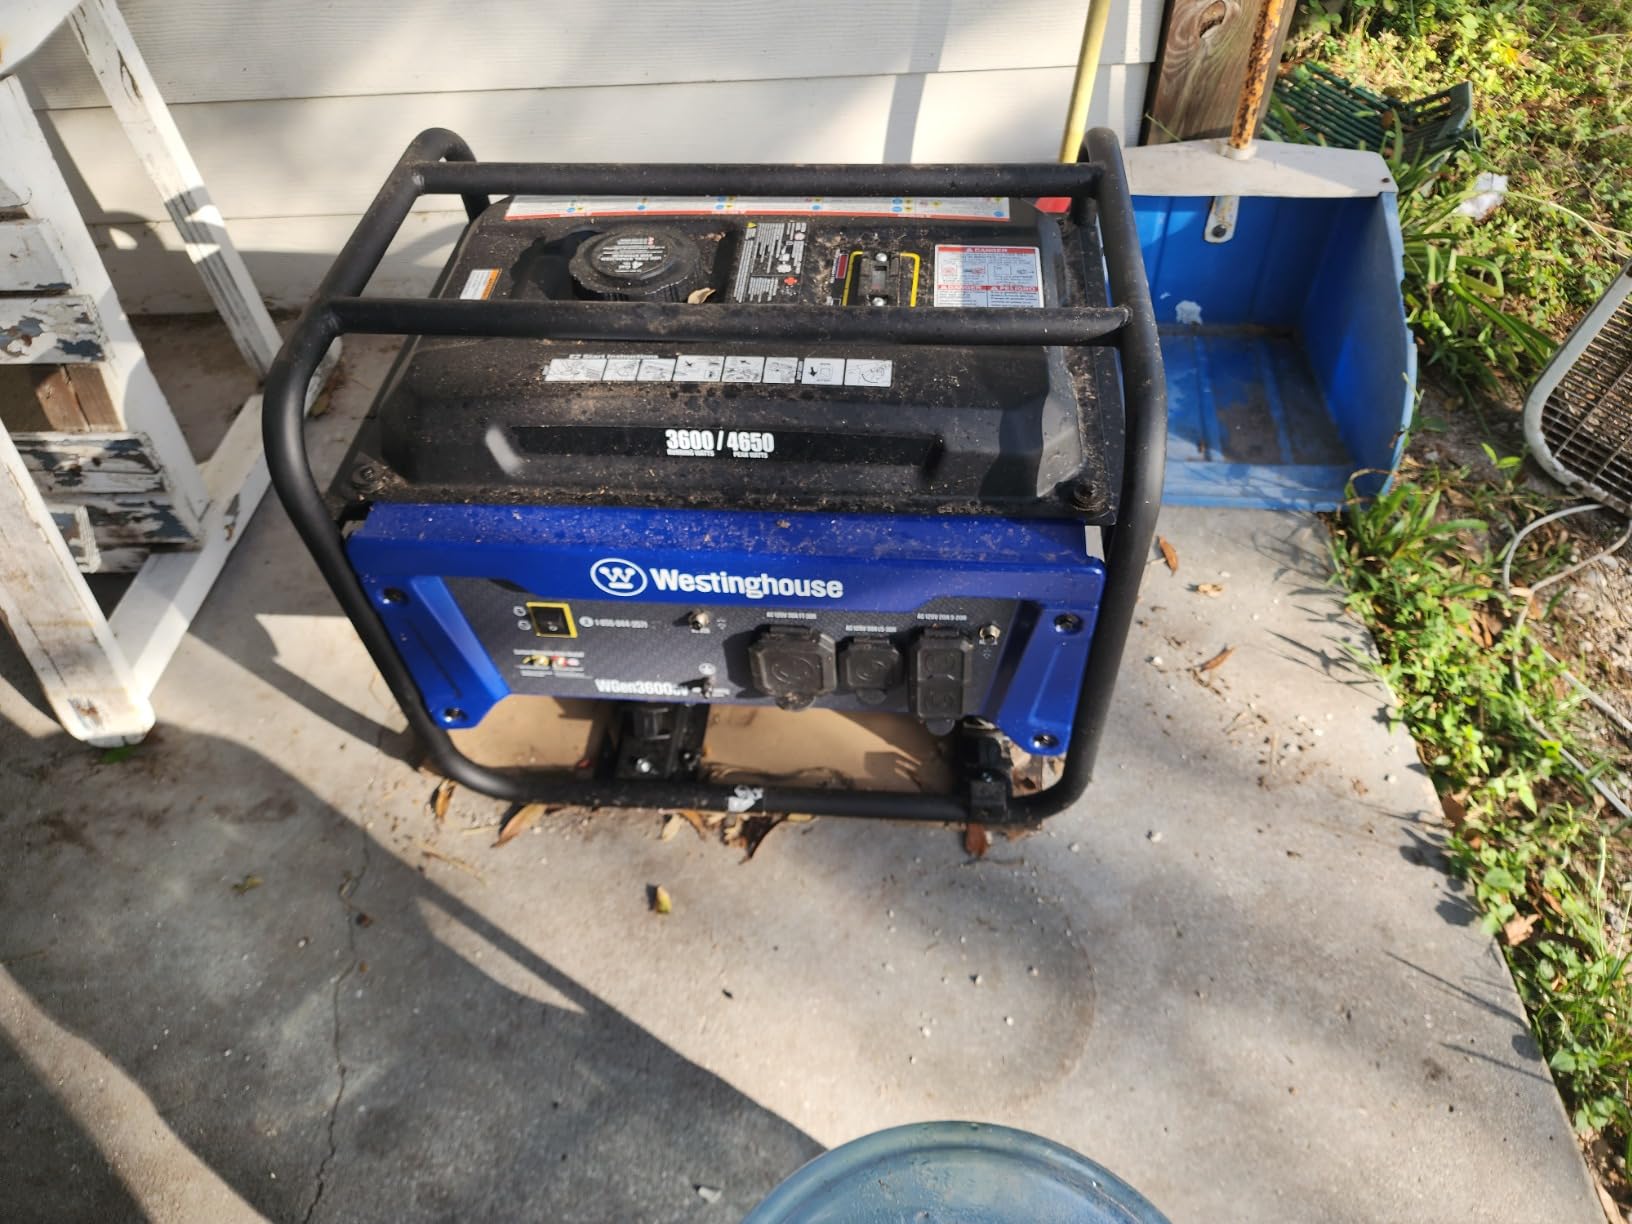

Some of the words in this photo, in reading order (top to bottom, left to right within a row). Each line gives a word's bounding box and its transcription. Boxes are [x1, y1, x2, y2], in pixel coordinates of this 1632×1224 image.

[665, 429, 715, 450] 3600
[717, 430, 725, 451] /
[727, 431, 775, 453] 4650
[649, 568, 844, 599] Westinghouse
